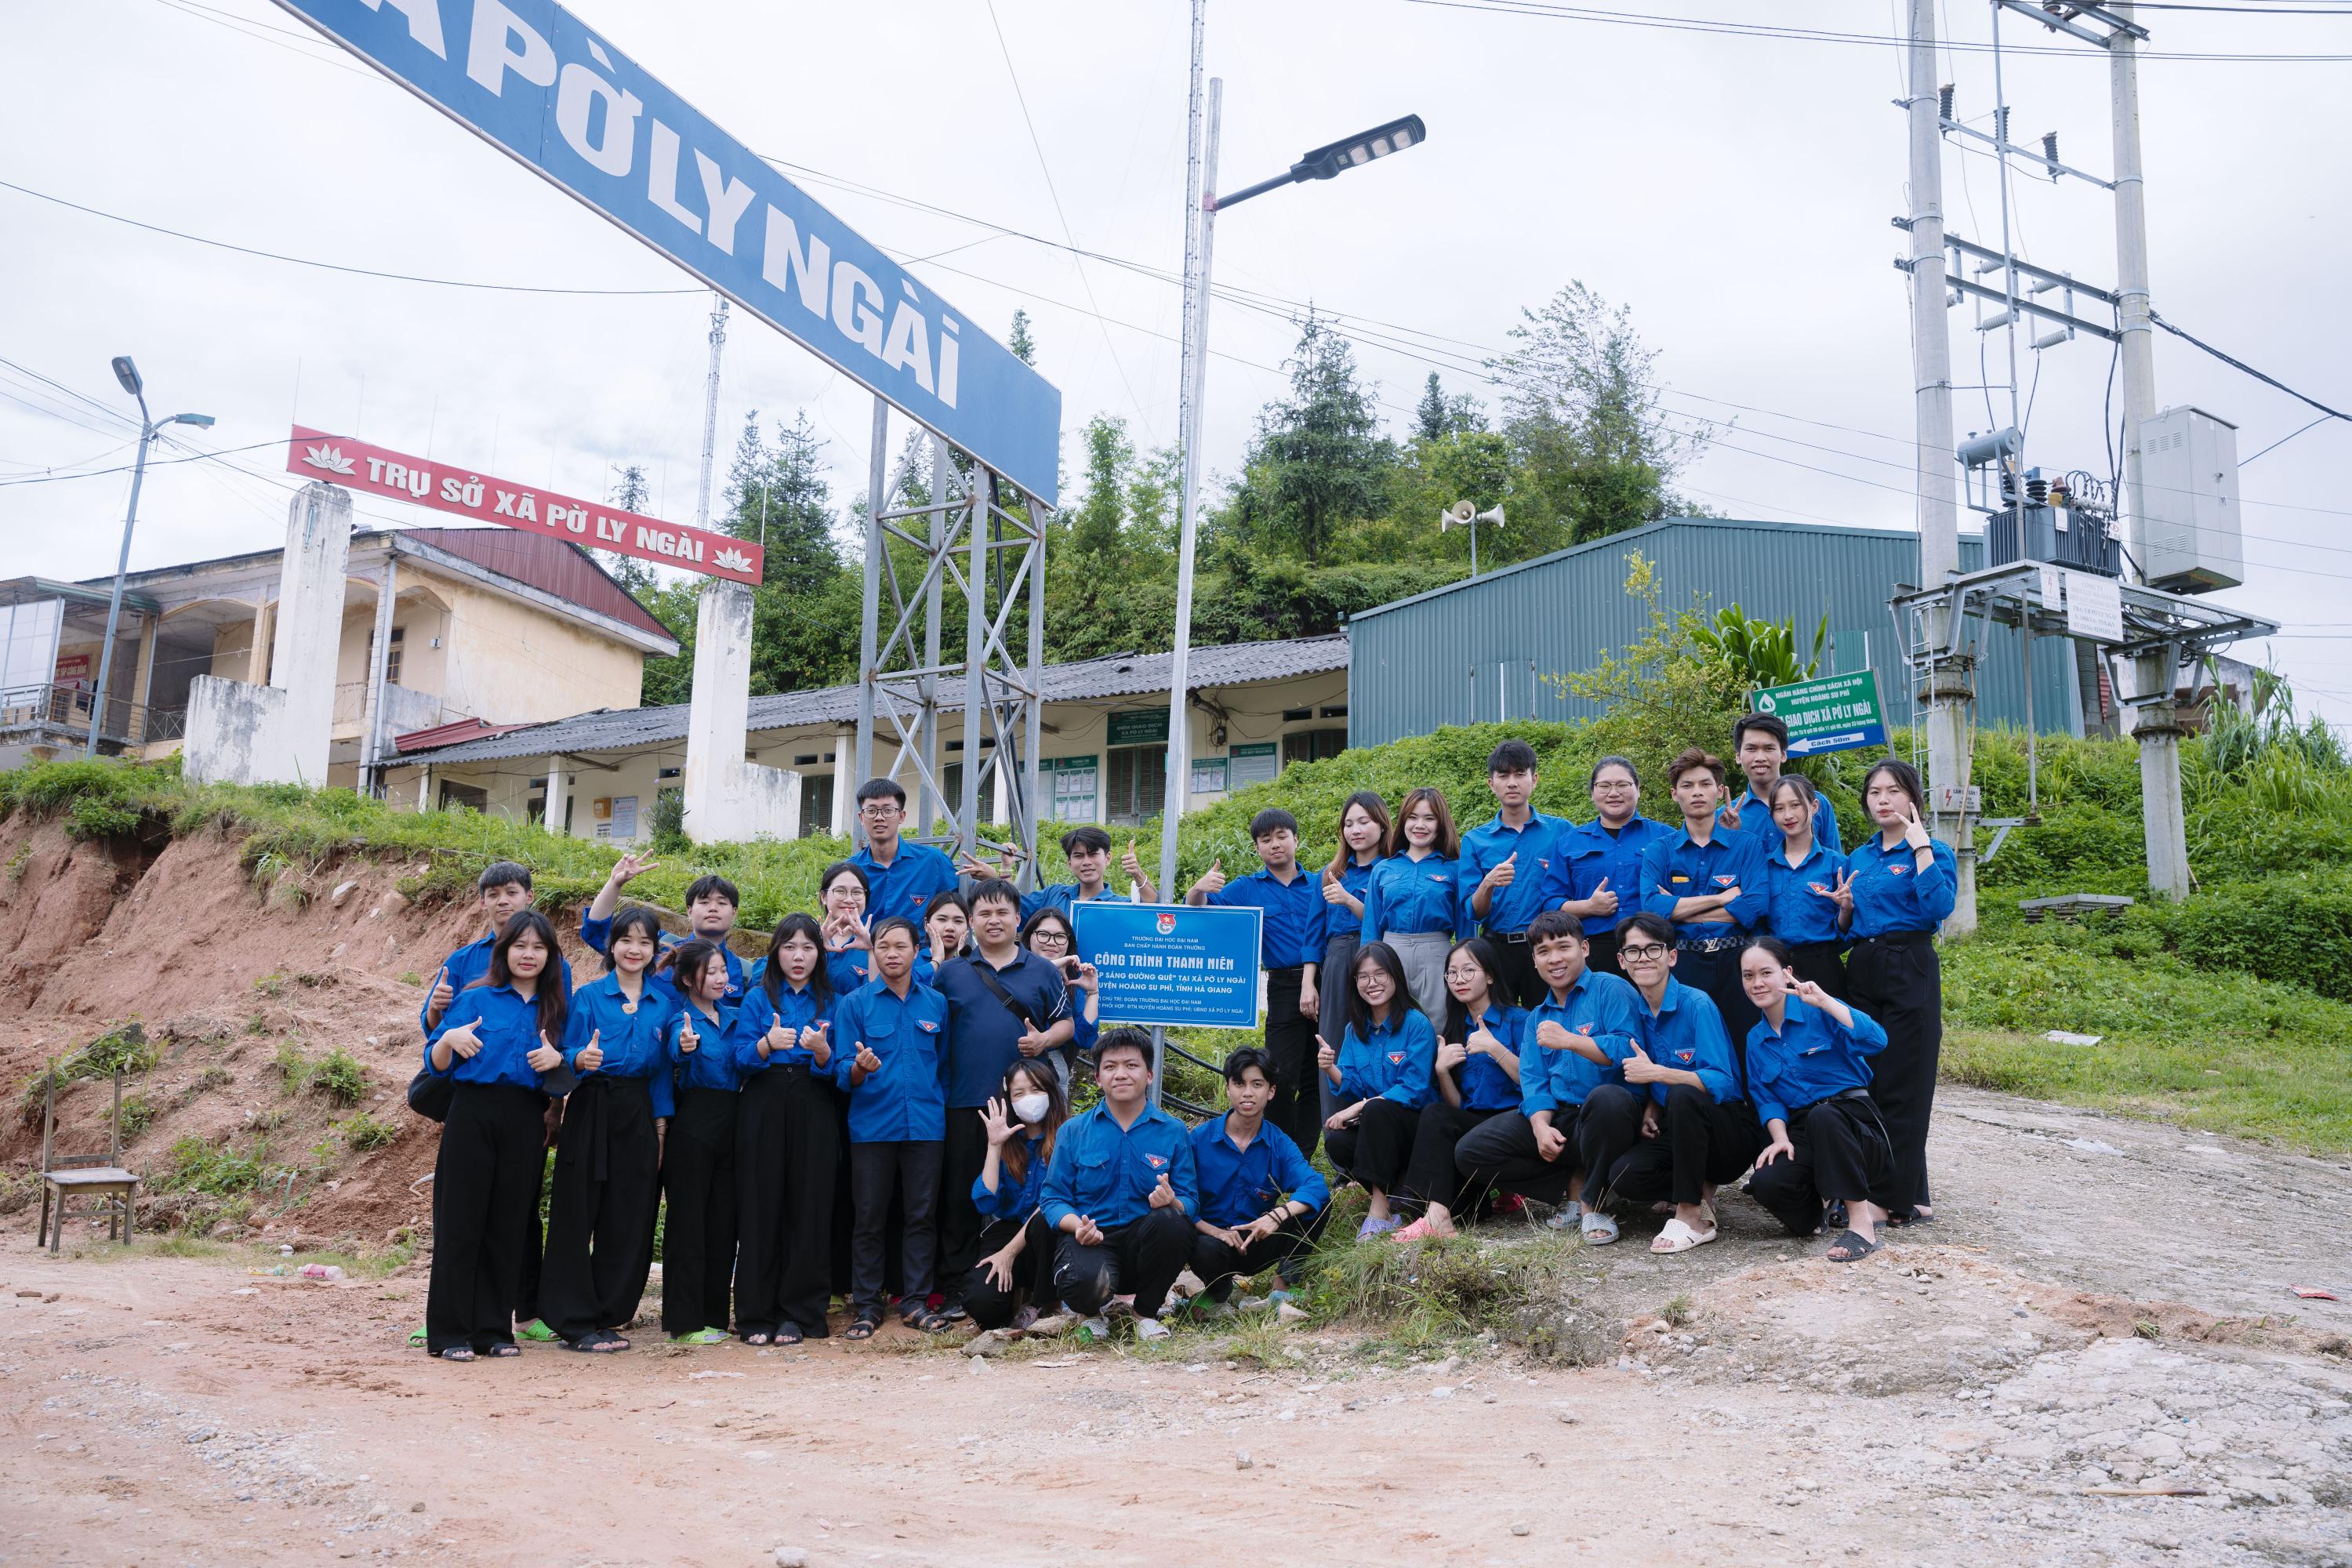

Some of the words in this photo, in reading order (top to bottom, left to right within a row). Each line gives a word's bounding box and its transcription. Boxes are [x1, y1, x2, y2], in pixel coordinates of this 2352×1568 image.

[466, 0, 643, 177] PỜ
[648, 118, 757, 256] LY
[366, 456, 431, 499] TRỤ
[440, 475, 485, 508] SỞ
[493, 489, 538, 522] XÃ
[546, 503, 589, 534] PỜ
[596, 517, 627, 543] LY
[636, 526, 704, 563] NGÀI
[1775, 690, 1791, 699] NGÂN
[1792, 688, 1808, 696] HÀNG
[1809, 684, 1827, 693] CHÍNH
[1827, 681, 1842, 690] SÁCH
[1852, 677, 1863, 687] HỘI
[1791, 696, 1810, 706] HUYỆN
[1810, 693, 1830, 702] HOÀNG
[1839, 688, 1850, 697] PHÌ
[1784, 713, 1802, 728] GIAO
[1802, 709, 1820, 727] DỊCH
[1831, 702, 1843, 720] PỜ
[1842, 704, 1852, 718] LY
[1852, 699, 1871, 717] NGÀI
[1094, 951, 1126, 966] CÔNG
[1130, 953, 1163, 967] TRÌNH
[1167, 956, 1203, 969] THANH
[1207, 956, 1234, 971] NIÊN
[1105, 971, 1127, 979] SÁNG
[1098, 981, 1117, 990] UYỆN
[1176, 983, 1192, 992] TỈNH
